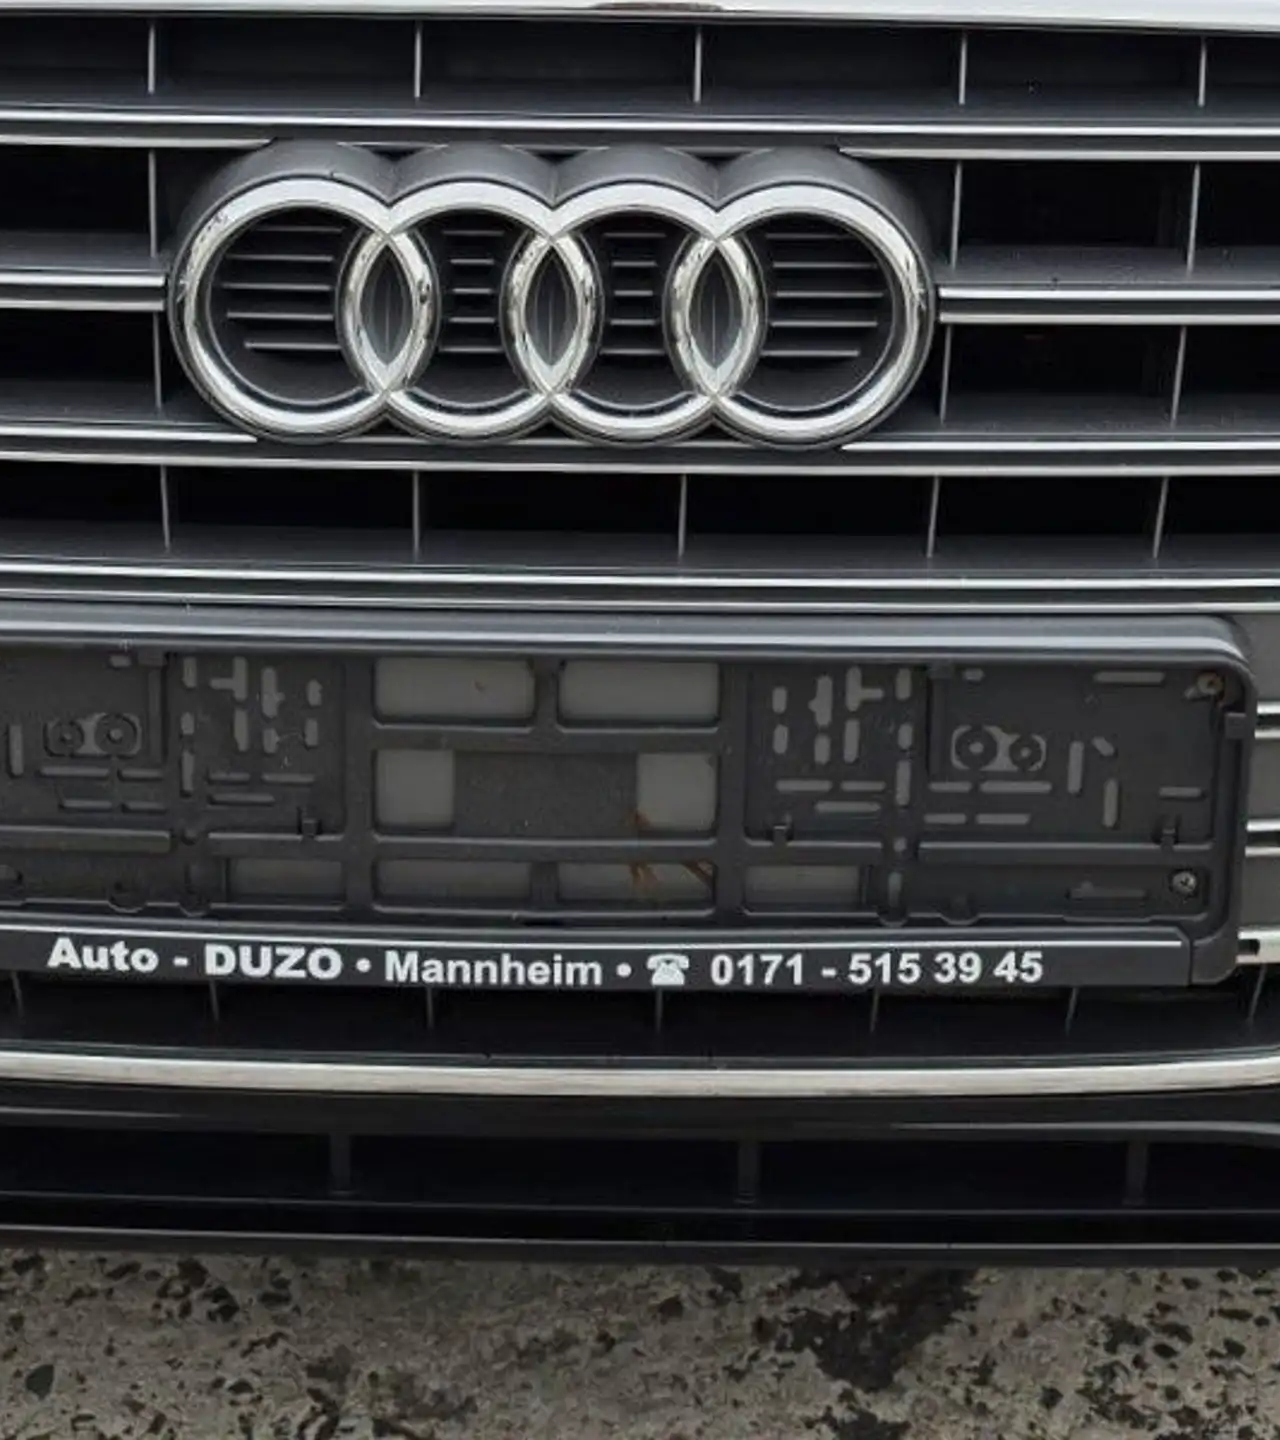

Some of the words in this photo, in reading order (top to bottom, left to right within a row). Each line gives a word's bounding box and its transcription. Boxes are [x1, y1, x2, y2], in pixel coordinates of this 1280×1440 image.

[47, 937, 159, 973] Auto
[204, 943, 343, 980] DUZO
[384, 950, 603, 986] Mannheim
[710, 952, 804, 986] 0171
[848, 952, 922, 985] 515
[933, 951, 983, 984] 39
[993, 950, 1044, 984] 45
